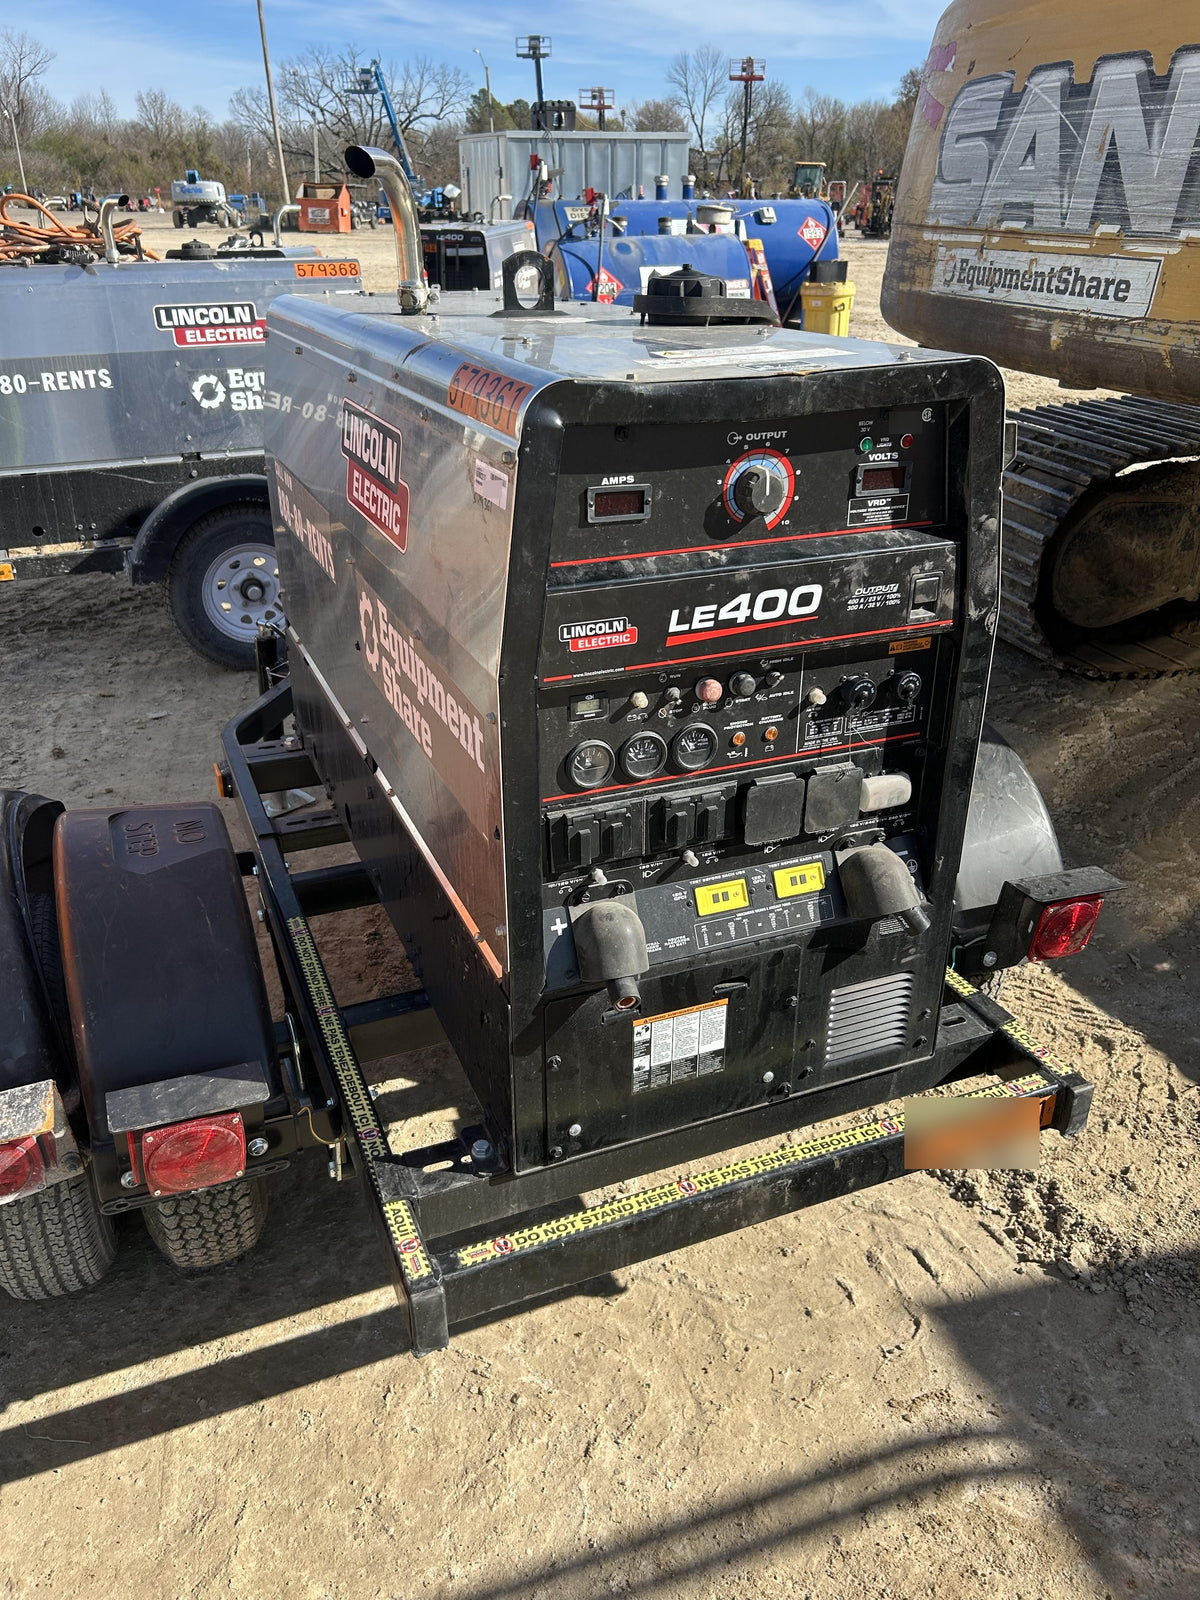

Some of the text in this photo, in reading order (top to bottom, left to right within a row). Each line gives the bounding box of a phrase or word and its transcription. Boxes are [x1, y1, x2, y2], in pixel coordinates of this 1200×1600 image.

[804, 229, 824, 238] 1993
[296, 262, 358, 278] 579368
[957, 258, 1132, 303] EquipmentShare
[160, 304, 251, 327] LINCOLN
[185, 326, 264, 343] ELECTRIC
[0, 368, 112, 395] 80-RENTS
[449, 365, 526, 431] 579361
[746, 430, 788, 441] OUTPUT
[343, 410, 399, 485] LINCOLN
[868, 452, 899, 462] VOLTS
[601, 475, 635, 486] AMPS
[352, 468, 401, 537] ELECTRIC
[668, 583, 823, 633] LE400
[562, 619, 624, 639] LINCOLN
[577, 633, 631, 649] ELECTRIC
[376, 598, 486, 774] Equipment
[380, 655, 433, 759] Share
[297, 936, 308, 948] DO
[302, 946, 314, 962] NOT
[306, 961, 321, 986] STAND
[314, 985, 328, 1007] HERE
[324, 1016, 334, 1028] NE
[327, 1028, 340, 1045] PAS
[1020, 1034, 1038, 1047] DO
[331, 1046, 351, 1072] TENEZ
[342, 1074, 366, 1114] DEBOUT
[357, 1113, 371, 1128] ICI
[515, 1230, 540, 1246] DO
[543, 1220, 577, 1239] NOT
[580, 1202, 634, 1226] STAND
[635, 1188, 678, 1209] HERE
[697, 1174, 718, 1188] NE
[720, 1165, 751, 1182] PAS
[750, 1149, 800, 1171] TENEZ
[800, 1133, 859, 1157] DEBOUT
[860, 1128, 881, 1142] ICI
[390, 1208, 413, 1237] AQUÍ
